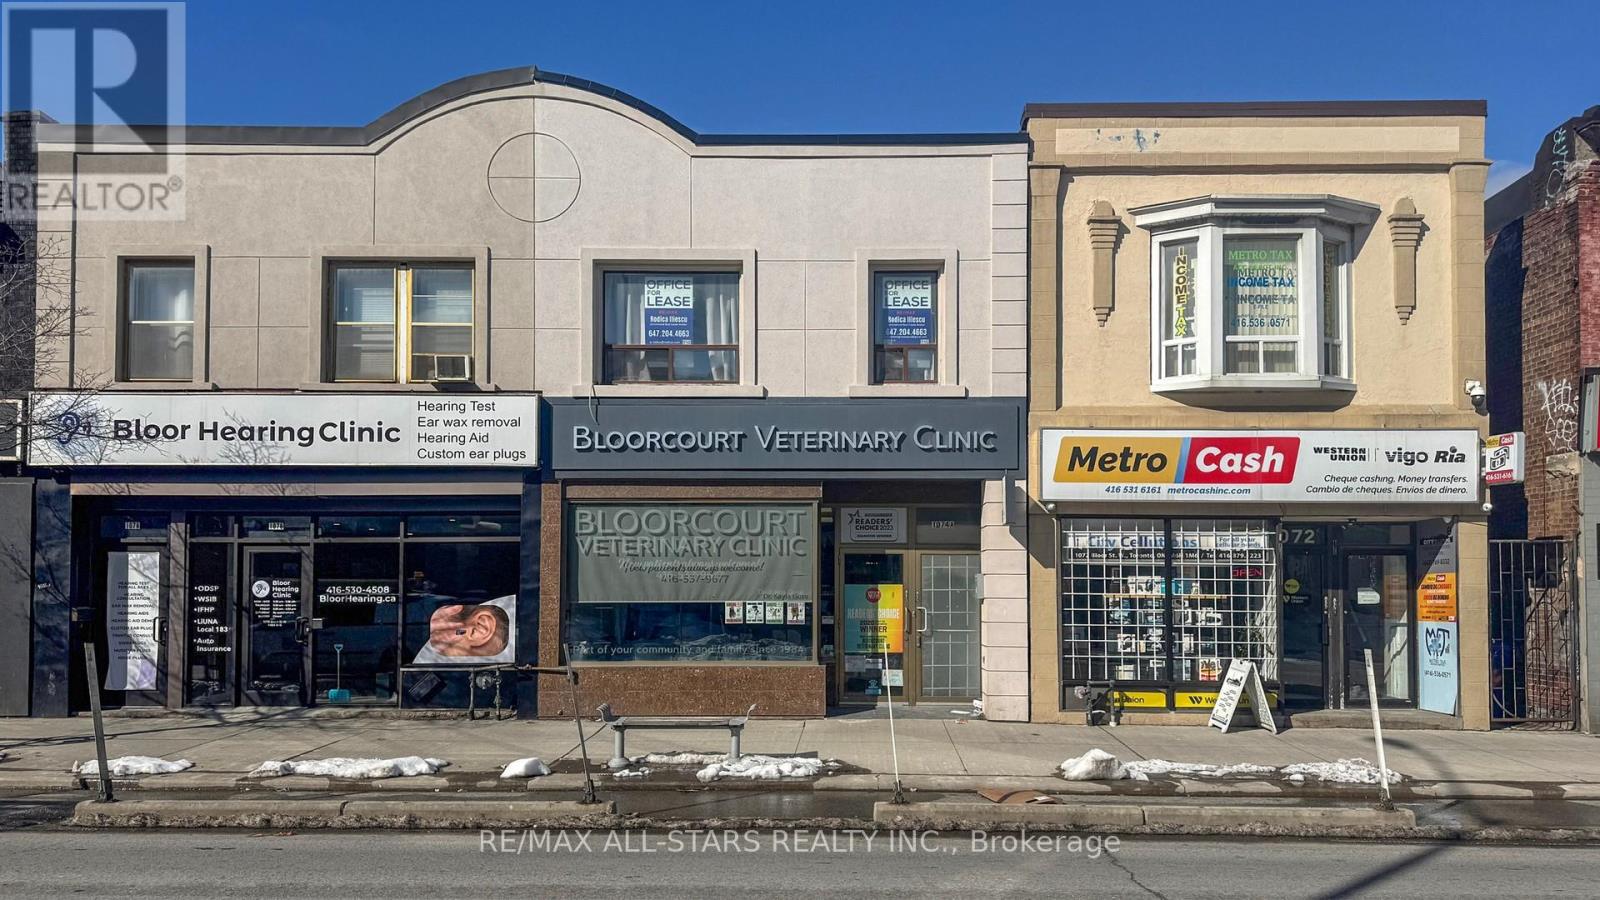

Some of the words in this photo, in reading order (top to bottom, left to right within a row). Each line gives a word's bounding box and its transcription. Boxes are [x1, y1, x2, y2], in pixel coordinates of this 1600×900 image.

[1229, 250, 1267, 260] METRO
[1270, 250, 1292, 260] TAX
[1175, 247, 1187, 304] INCOME
[647, 280, 690, 289] OFFICE
[885, 280, 928, 289] OFFICE
[1272, 277, 1294, 287] TAX
[647, 296, 690, 307] LEASE
[885, 296, 928, 307] LEASE
[1175, 307, 1187, 336] TAX
[417, 401, 466, 413] Hearing
[470, 401, 496, 411] Test
[417, 416, 440, 427] Ear
[443, 419, 468, 427] wax
[471, 416, 521, 427] removal
[113, 418, 191, 440] Bloor
[199, 420, 315, 447] Hearing
[318, 420, 401, 442] Clinic
[417, 432, 466, 446] Hearing
[469, 432, 489, 443] Aid
[417, 448, 465, 459] Custom
[469, 450, 489, 459] ear
[493, 448, 527, 461] plugs
[1067, 446, 1168, 473] Metro
[1195, 445, 1285, 473] Cash
[1385, 447, 1428, 466] vigo
[1434, 446, 1466, 463] Ria
[1324, 475, 1357, 485] Cheque
[1359, 474, 1396, 484] cashing.
[1398, 474, 1426, 484] Money
[1428, 474, 1469, 484] transfers.
[1105, 486, 1121, 494] 416
[1122, 486, 1139, 494] 531
[1140, 486, 1161, 494] 6161
[1167, 486, 1251, 495] metrocashinc.com
[1306, 485, 1340, 494] Cambio
[1342, 485, 1353, 494] de
[1356, 485, 1394, 495] cheques.
[1396, 485, 1424, 494] Envios
[1426, 485, 1437, 494] de
[1439, 485, 1468, 494] dinero.
[575, 509, 807, 537] BLOORCOURT
[576, 536, 727, 557] VETERINARY
[729, 536, 807, 557] CLINIC
[1088, 534, 1116, 551] City
[1232, 567, 1264, 577] OPEN
[326, 586, 390, 594] 416-530-4508
[319, 595, 396, 604] BloorHearing.ca
[597, 644, 608, 654] of
[610, 646, 633, 656] your
[636, 645, 692, 656] community
